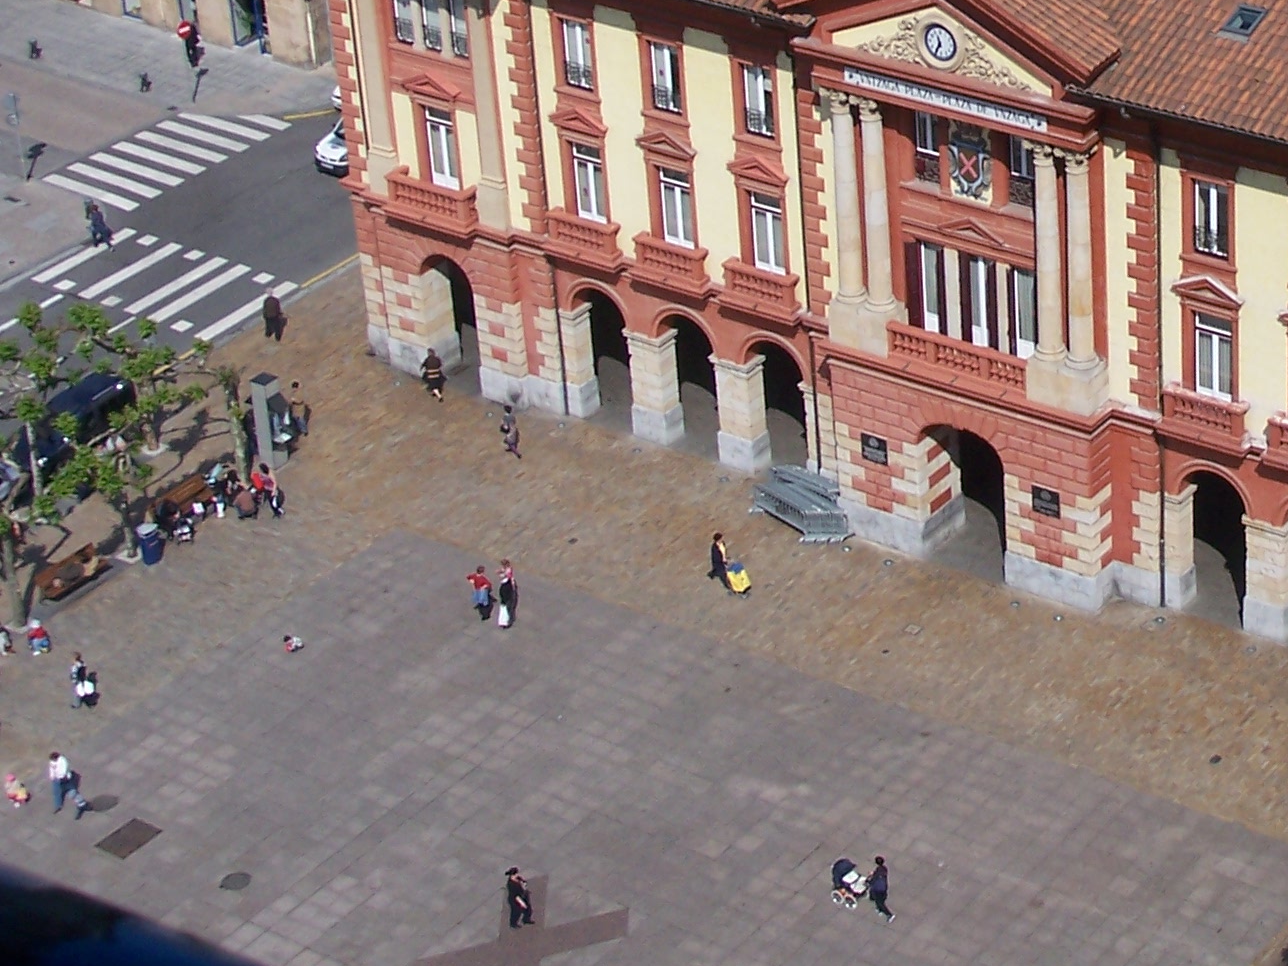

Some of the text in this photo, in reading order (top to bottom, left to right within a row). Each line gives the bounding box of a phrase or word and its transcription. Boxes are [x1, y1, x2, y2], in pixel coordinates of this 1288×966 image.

[904, 82, 934, 101] PLAZA
[941, 93, 972, 111] PLAZA
[976, 102, 987, 114] DE
